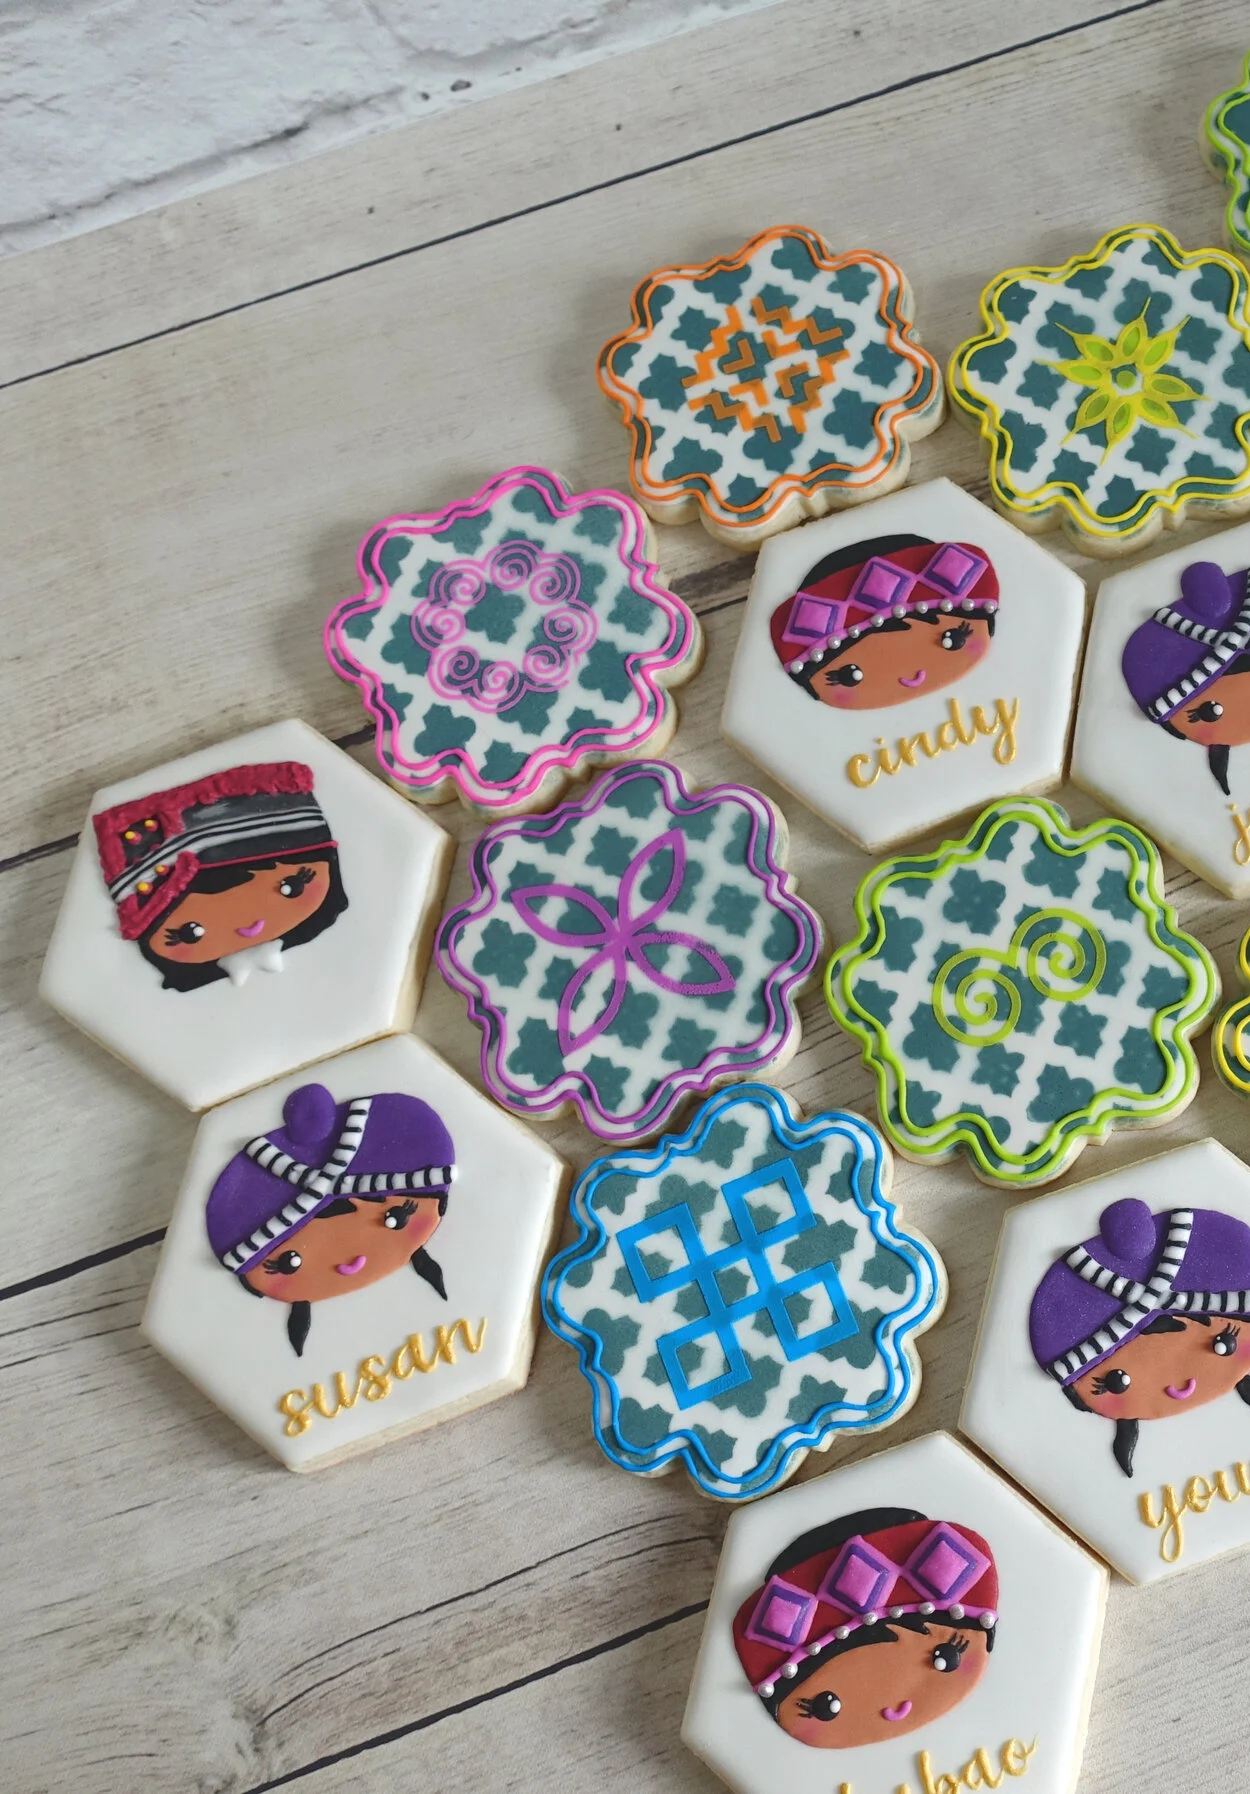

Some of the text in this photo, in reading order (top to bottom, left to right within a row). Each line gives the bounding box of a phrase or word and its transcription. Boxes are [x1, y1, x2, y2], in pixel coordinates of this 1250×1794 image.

[847, 693, 1017, 788] cindy
[276, 1314, 488, 1437] susan
[839, 1734, 1038, 1794] bao
